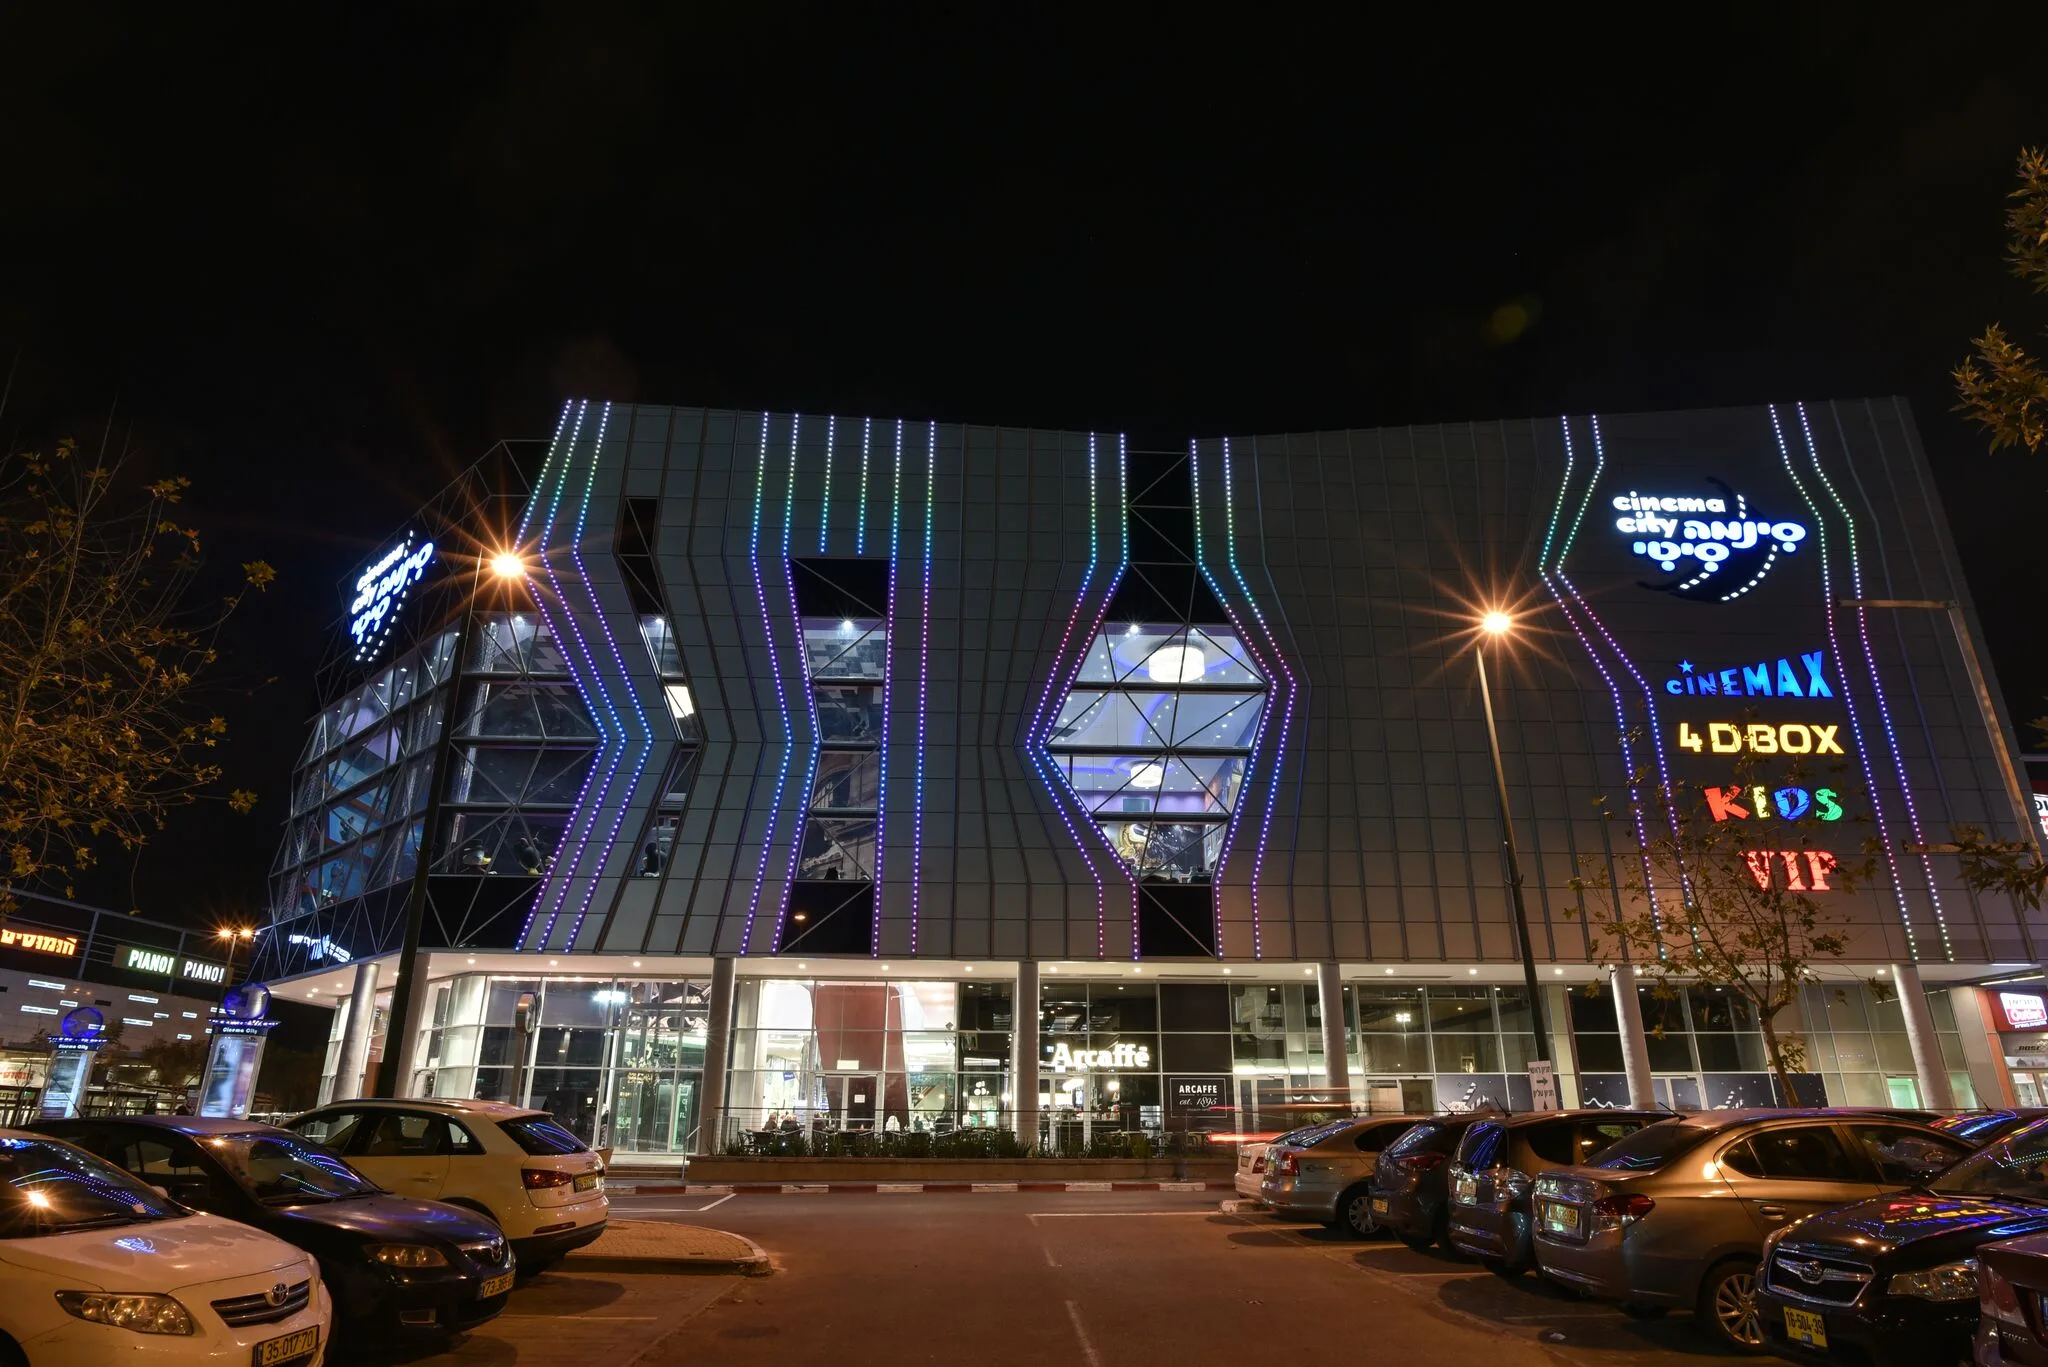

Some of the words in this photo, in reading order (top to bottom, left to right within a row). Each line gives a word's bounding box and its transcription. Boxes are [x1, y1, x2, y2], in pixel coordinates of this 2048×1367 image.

[1613, 490, 1726, 513] cinema
[1616, 511, 1678, 538] city
[1683, 520, 1806, 552] סינמה
[1633, 541, 1730, 572] סיטי
[1704, 785, 1843, 822] KIDS
[1740, 851, 1837, 892] VIP
[128, 948, 176, 975] PIANO!
[184, 960, 226, 984] PIANO!
[1178, 1084, 1218, 1094] ARCAFFE
